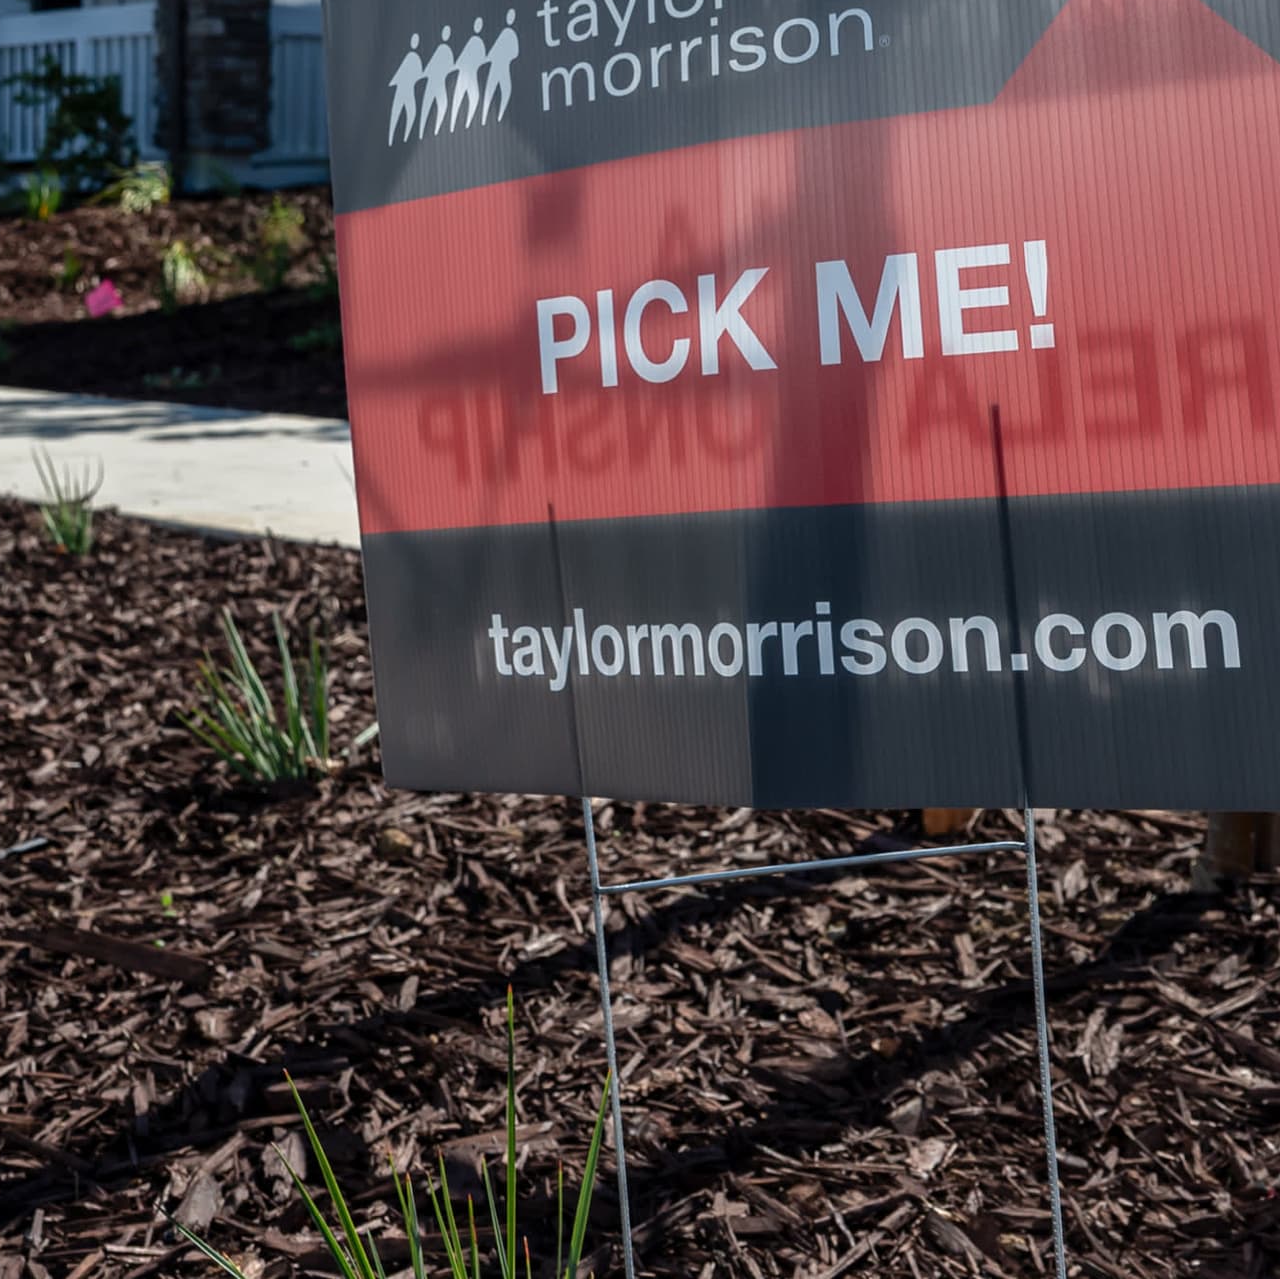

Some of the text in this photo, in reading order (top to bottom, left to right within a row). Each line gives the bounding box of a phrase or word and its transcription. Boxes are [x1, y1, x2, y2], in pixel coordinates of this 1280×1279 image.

[540, 7, 874, 111] morrison
[535, 266, 779, 396] PICK
[815, 239, 1056, 366] ME!
[488, 601, 1242, 693] taylormorrison.com
